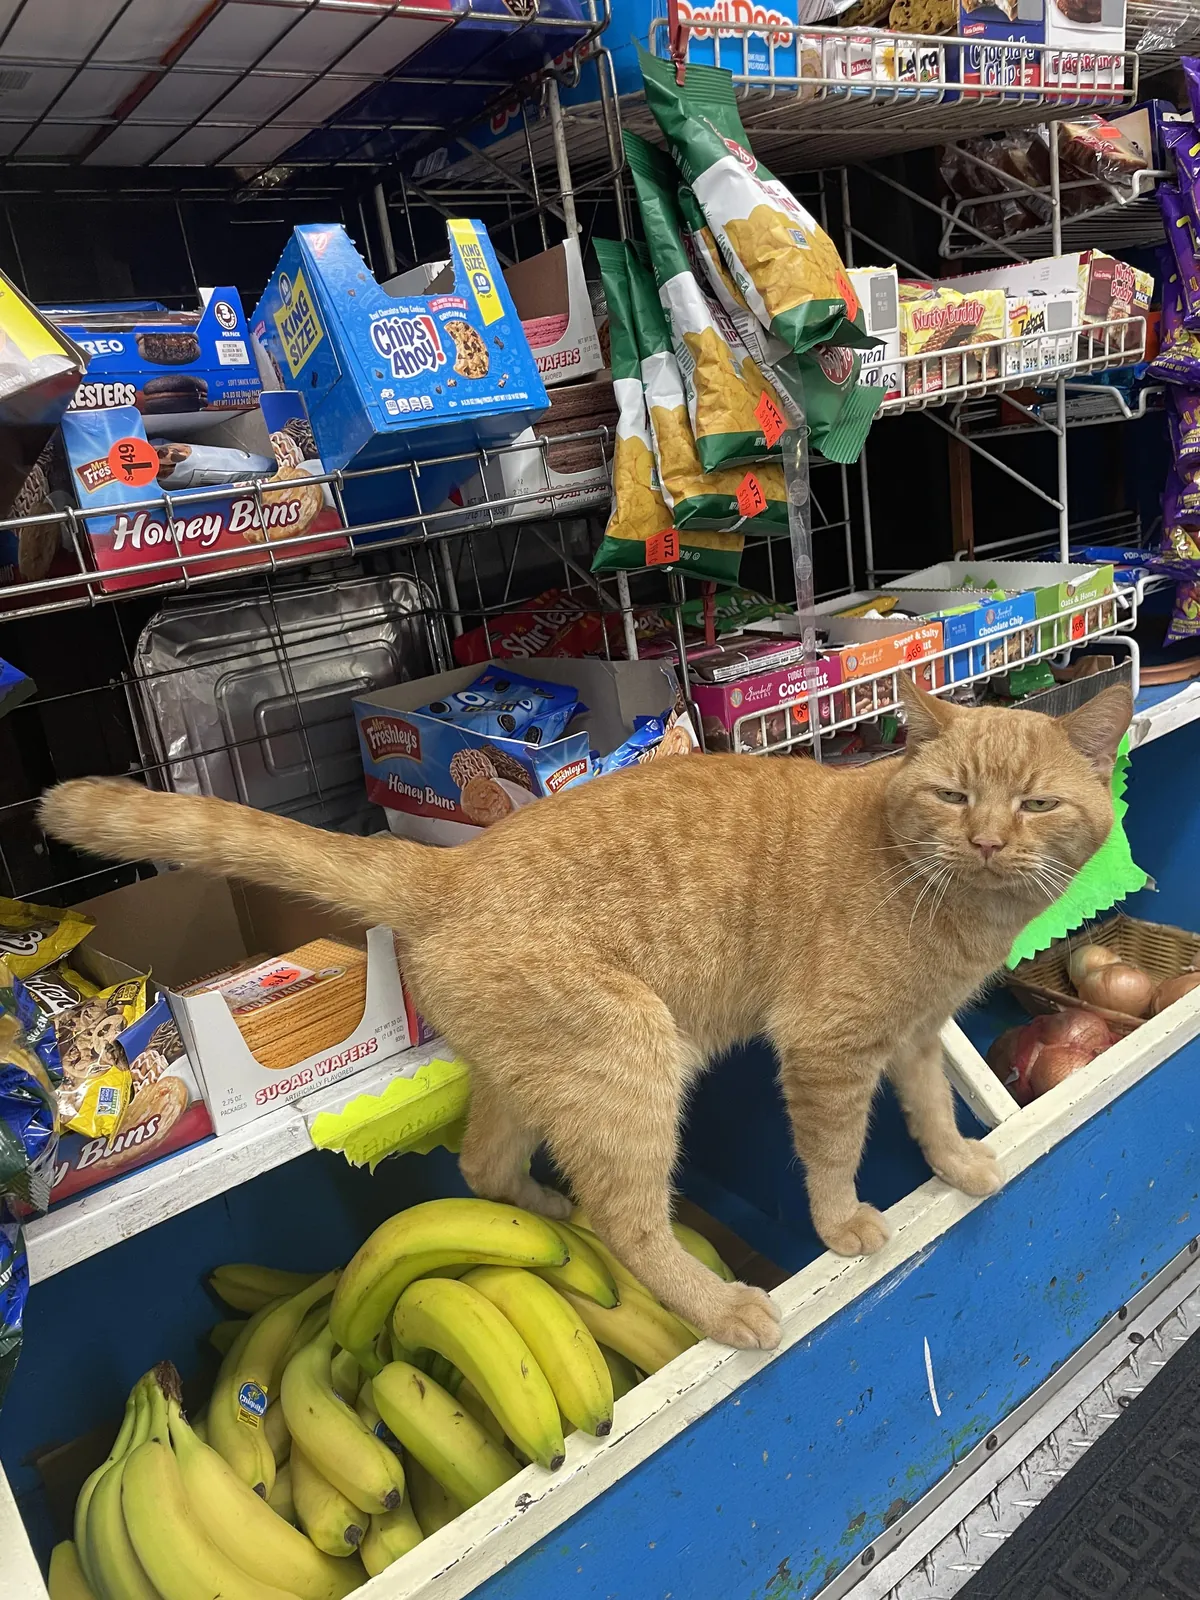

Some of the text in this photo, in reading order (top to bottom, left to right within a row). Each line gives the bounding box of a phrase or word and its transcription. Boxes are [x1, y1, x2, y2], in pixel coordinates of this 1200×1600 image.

[731, 0, 792, 45] Dogs
[459, 243, 482, 257] KING
[463, 257, 487, 272] SIZE!
[1115, 263, 1135, 287] Nutty
[476, 275, 487, 286] 10
[1111, 279, 1133, 305] Buddy
[1135, 291, 1149, 304] PACK
[218, 303, 231, 320] 3
[280, 289, 310, 346] KING
[911, 300, 985, 333] Nutty Buddy
[289, 314, 319, 367] SIZE!
[372, 318, 427, 357] Chips
[392, 316, 446, 376] Ahoy!
[766, 399, 783, 428] UTZ
[748, 478, 762, 508] UTZ
[113, 500, 300, 550] Honey Buns
[663, 533, 674, 558] UTZ
[1060, 598, 1074, 608] Oats
[1080, 590, 1097, 601] Honey
[501, 598, 585, 660] Shirley
[893, 634, 914, 650] Sweet
[914, 631, 921, 640] &
[921, 627, 939, 639] Salty
[978, 621, 1009, 636] Chocolate
[1009, 616, 1024, 627] Chip
[778, 672, 829, 697] Coconut
[788, 671, 803, 682] FUDGE
[366, 724, 418, 755] Freshley's
[549, 761, 586, 790] Freshley's
[388, 773, 456, 811] Honey Buns
[374, 1024, 383, 1035] NET
[383, 1021, 391, 1031] WT
[397, 1015, 403, 1025] OZ
[255, 1038, 378, 1106] SUGAR WAFERS
[284, 1065, 354, 1103] ARTIFICIALLY FLAVORED
[222, 1094, 242, 1107] 2.75 OZ
[227, 1087, 234, 1095] 12
[220, 1101, 248, 1117] PACKAGES
[77, 1116, 160, 1170] Buns
[240, 1393, 264, 1414] Chiquita
